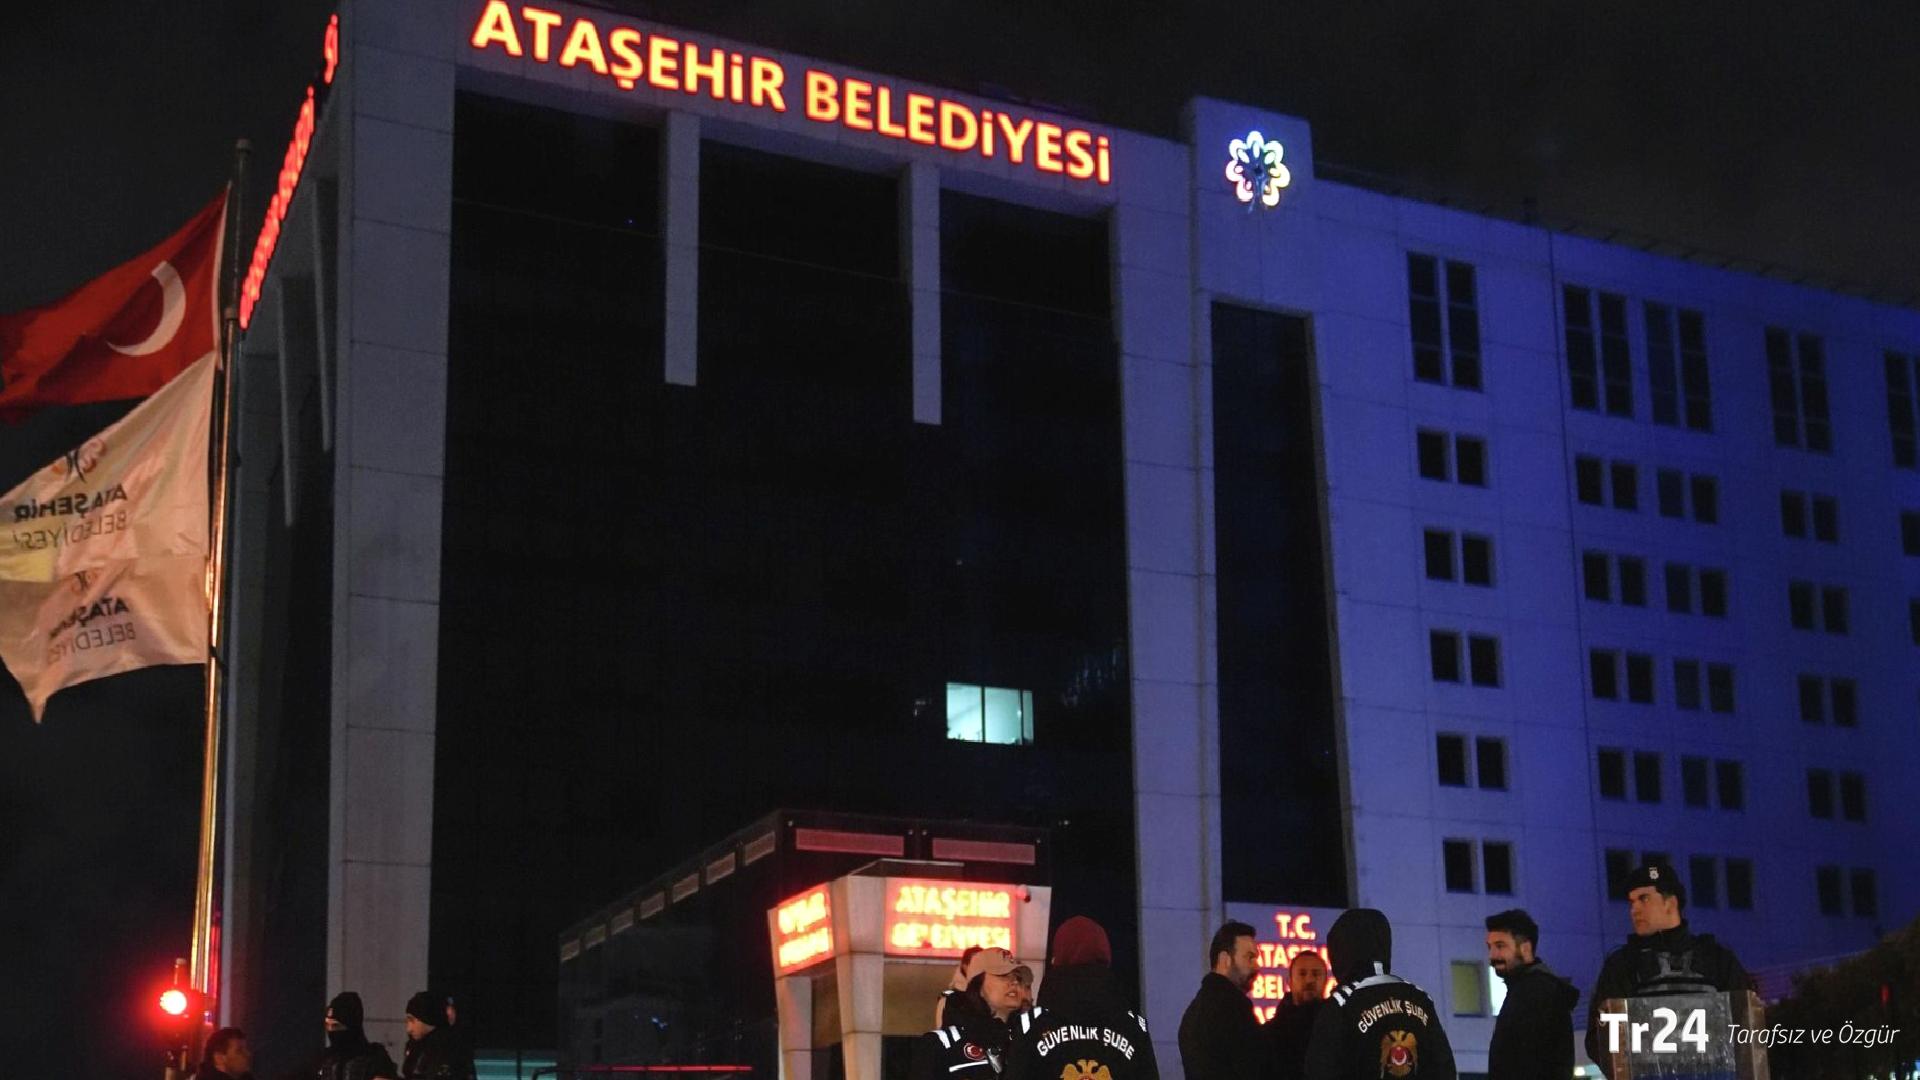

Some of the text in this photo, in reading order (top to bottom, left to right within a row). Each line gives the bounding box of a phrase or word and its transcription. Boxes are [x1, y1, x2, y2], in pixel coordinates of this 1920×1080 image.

[1275, 914, 1316, 940] T.C.
[1404, 1001, 1429, 1026] ŞUBE
[1103, 1029, 1135, 1060] ŞUBE
